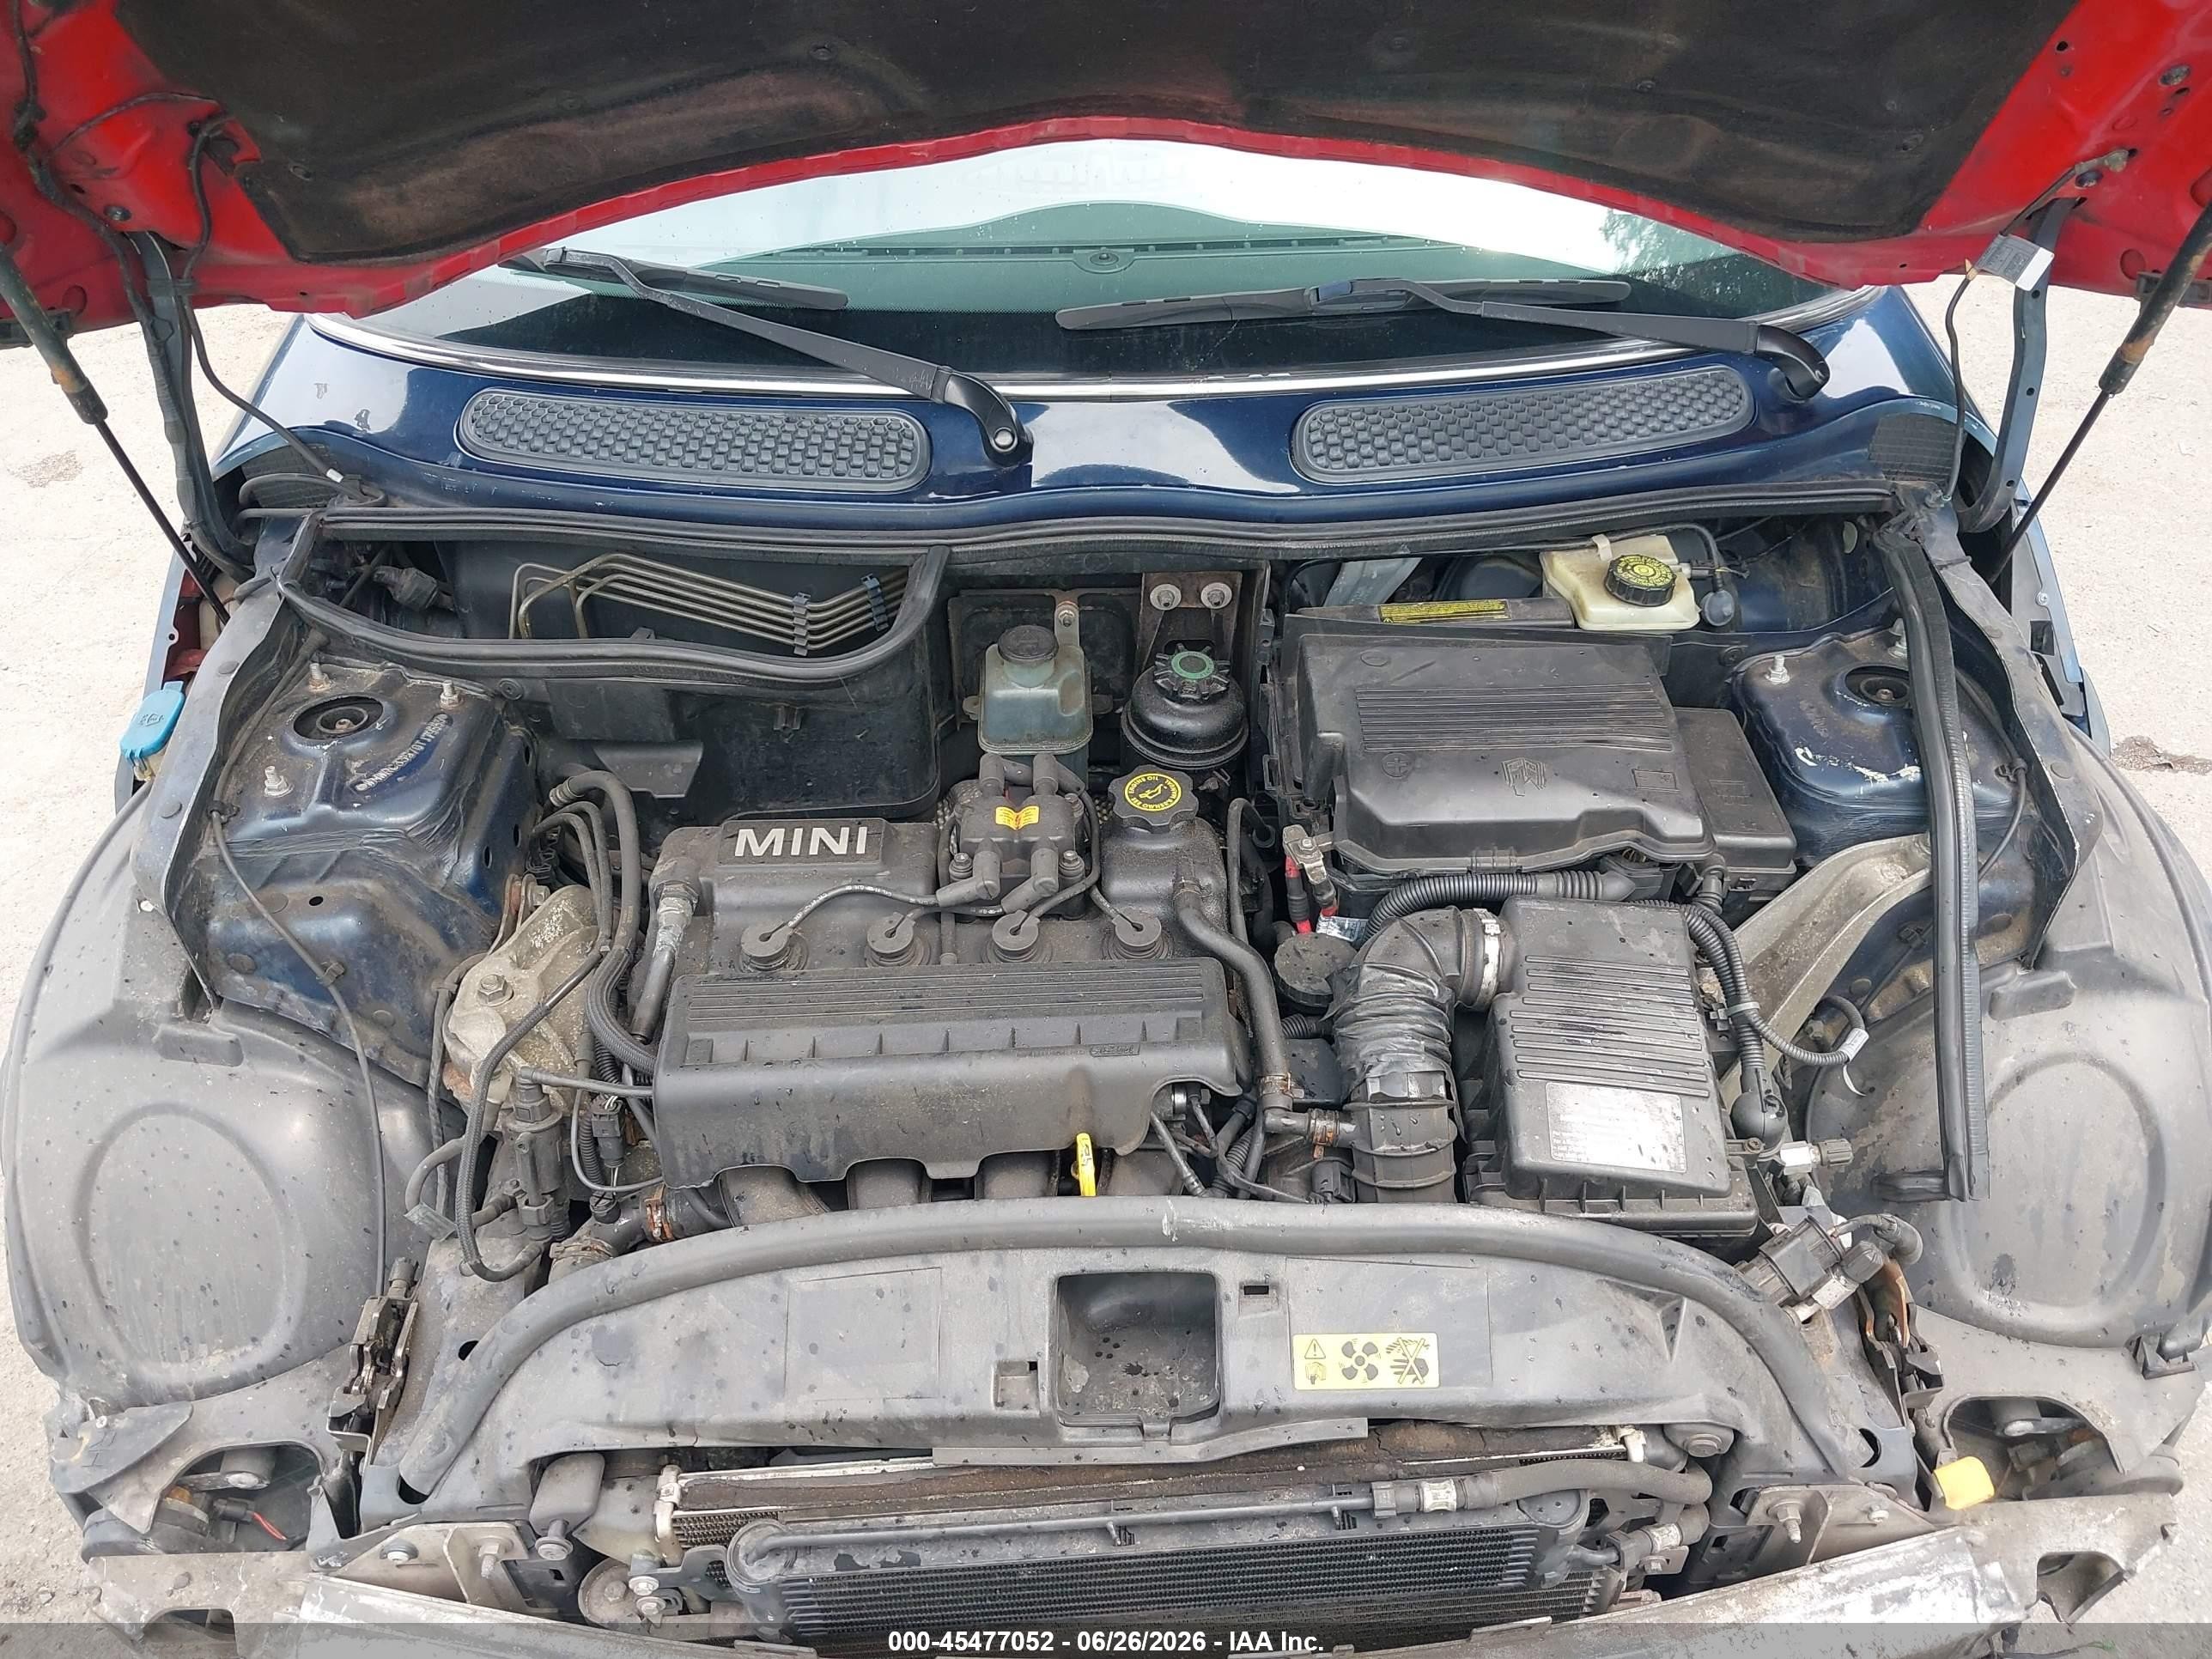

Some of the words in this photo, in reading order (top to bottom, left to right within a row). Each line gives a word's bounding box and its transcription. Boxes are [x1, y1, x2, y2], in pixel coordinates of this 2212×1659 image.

[1128, 776, 1146, 793] ENGINE
[1131, 797, 1142, 805] SEE
[734, 826, 868, 856] MINI
